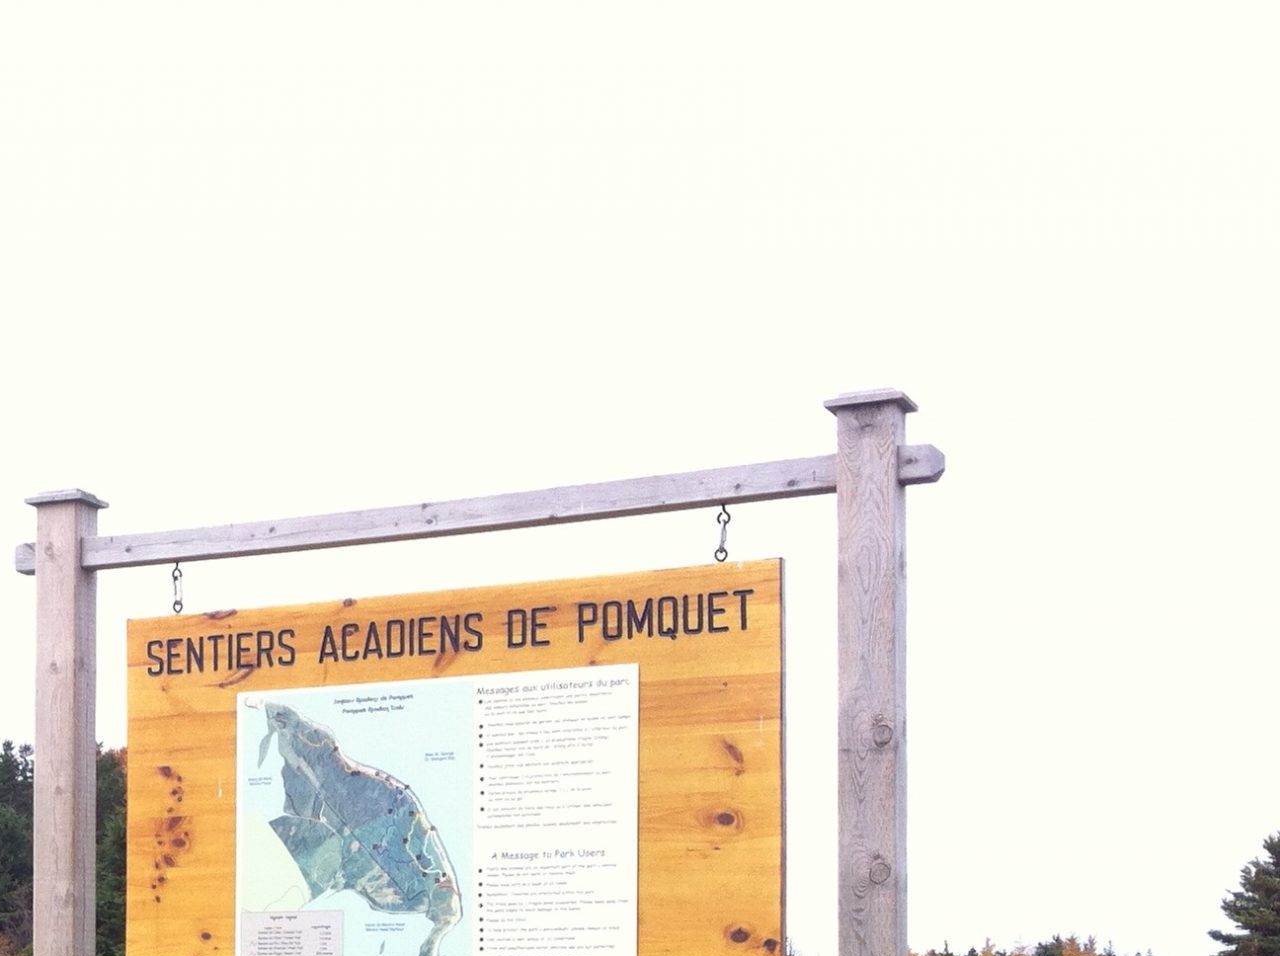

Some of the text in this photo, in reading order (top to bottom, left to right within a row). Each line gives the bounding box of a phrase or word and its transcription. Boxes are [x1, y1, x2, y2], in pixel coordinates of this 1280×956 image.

[146, 588, 755, 677] SENTIERS ACADIENS DE POMQUET
[476, 678, 631, 696] Messages aux utilisateurs du parc
[491, 852, 498, 860] A
[501, 851, 539, 862] Message
[554, 849, 575, 859] Park
[578, 849, 606, 857] Users
